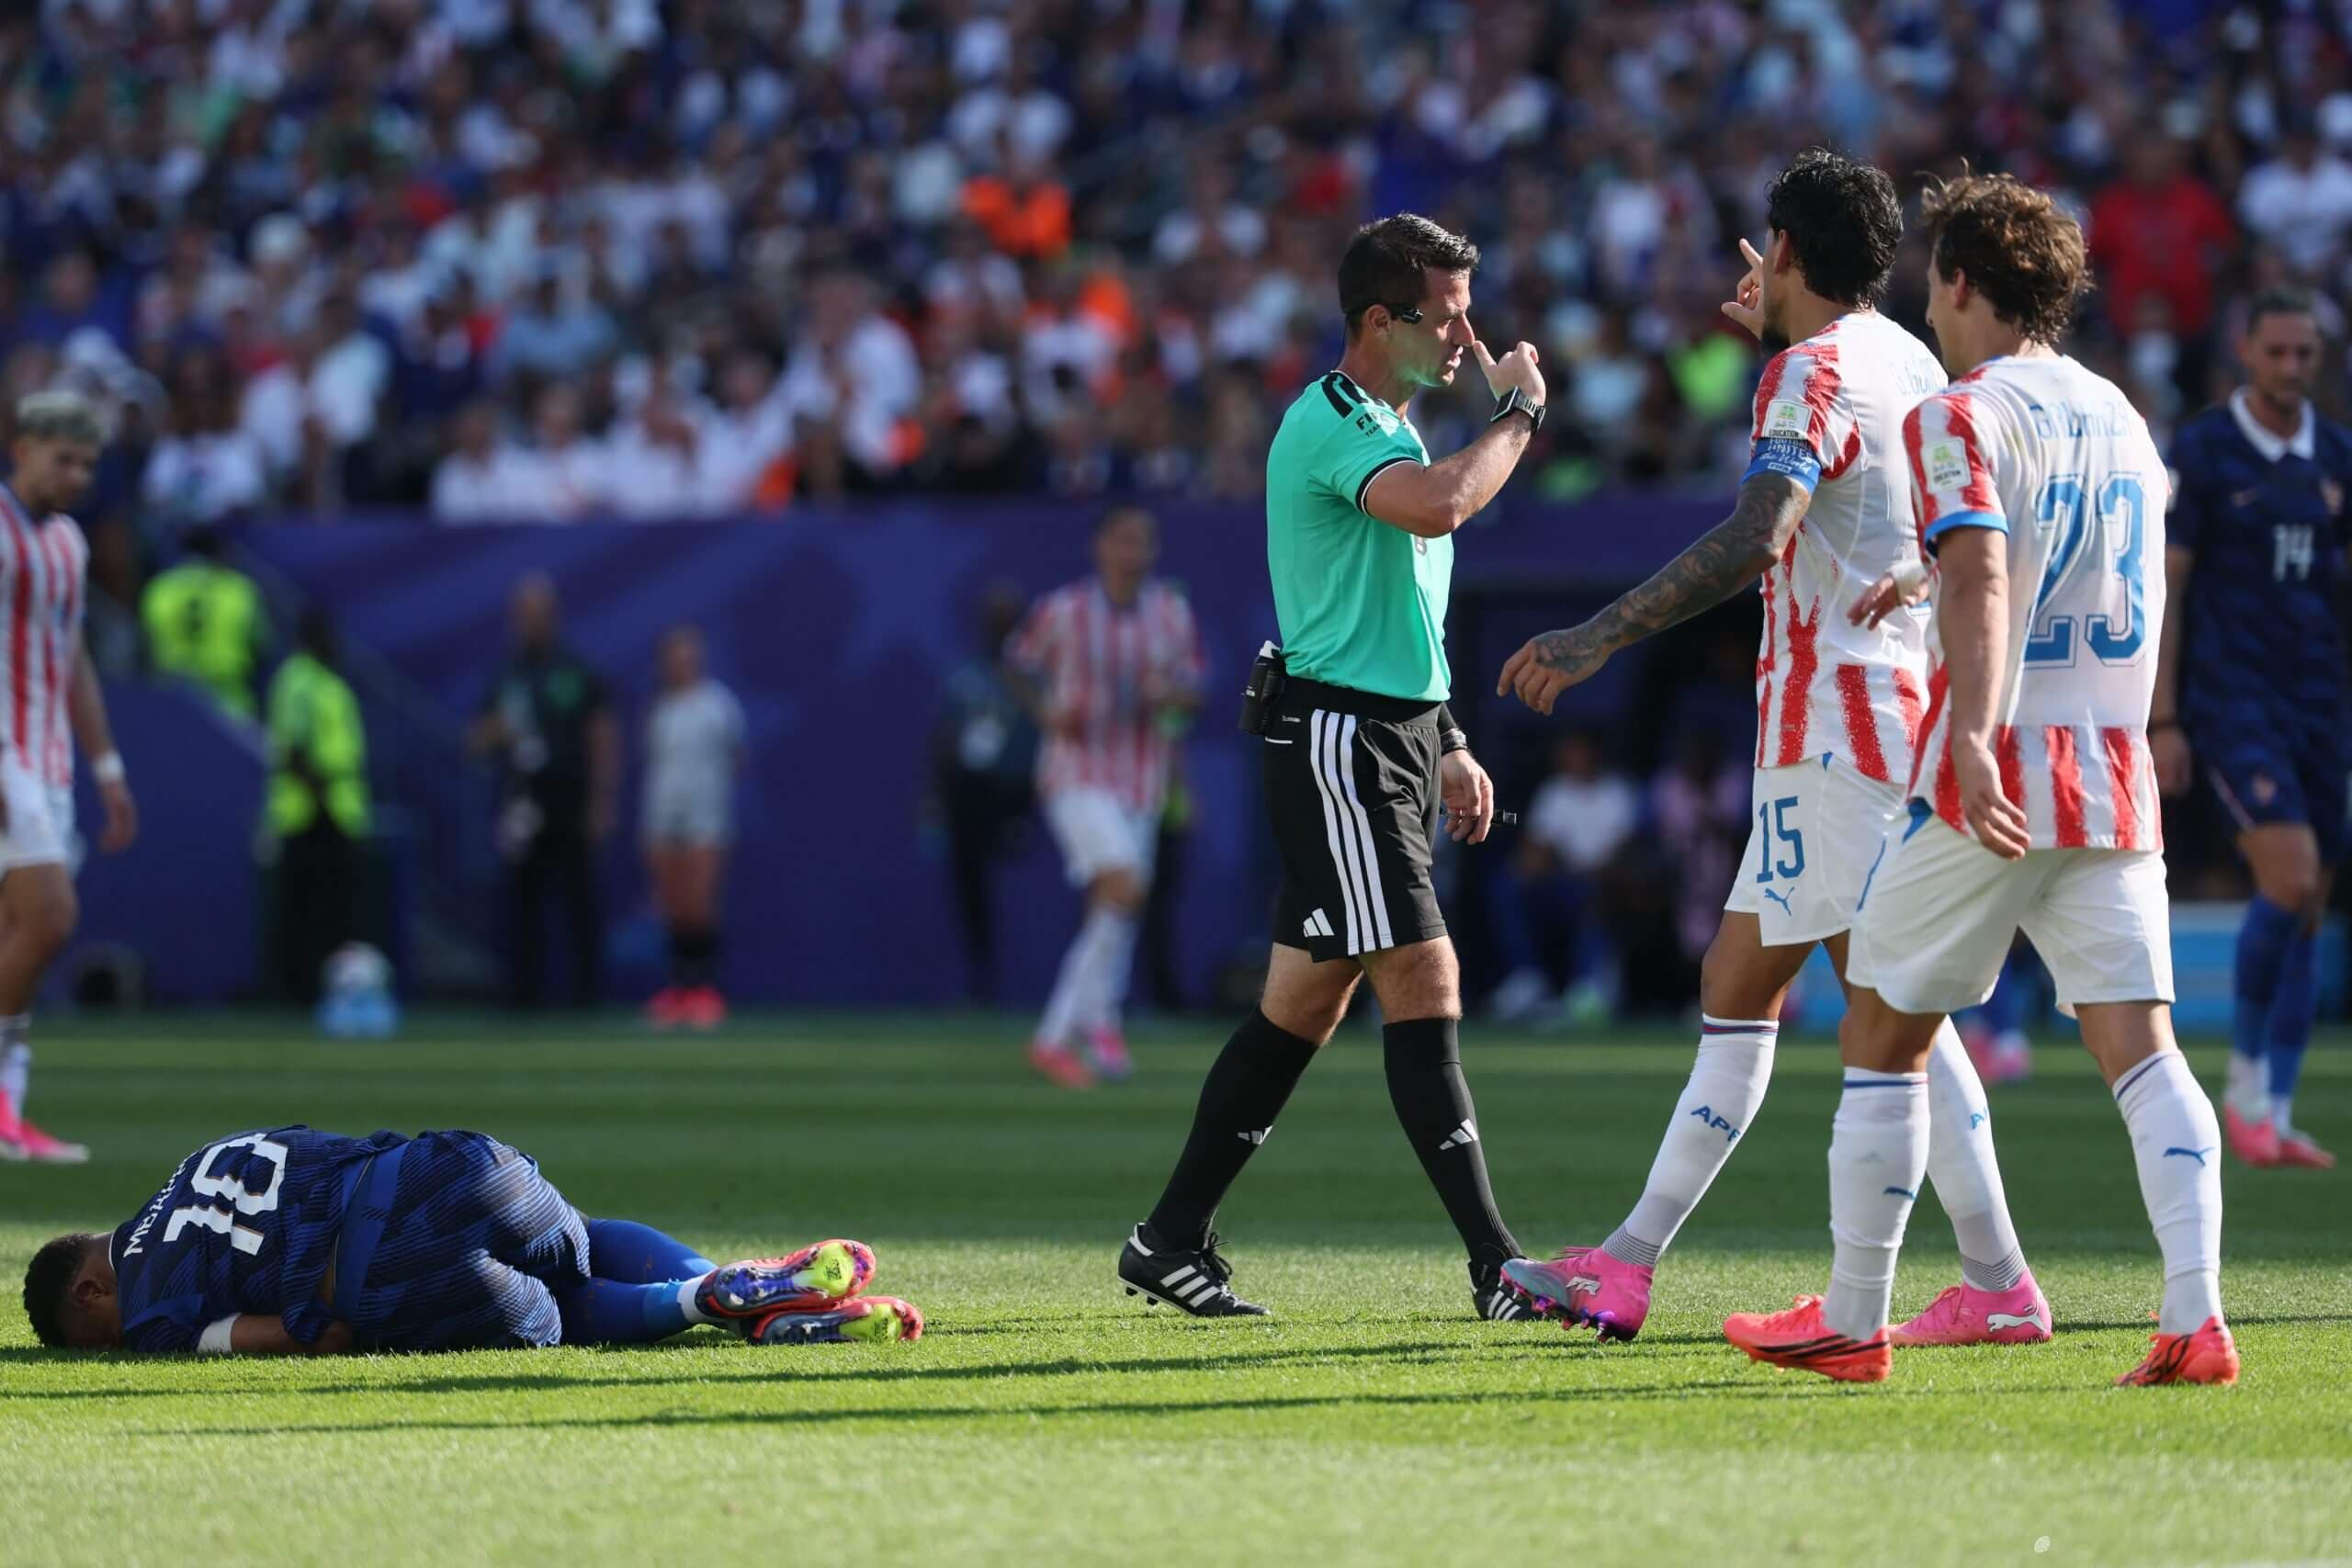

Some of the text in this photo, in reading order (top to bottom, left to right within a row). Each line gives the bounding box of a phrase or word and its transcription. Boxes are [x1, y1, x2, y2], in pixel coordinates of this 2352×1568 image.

[1769, 428, 1800, 438] EDUCATION
[2024, 471, 2147, 669] 23
[2272, 524, 2314, 581] 14
[1757, 795, 1805, 883] 15
[163, 1132, 288, 1257] 10
